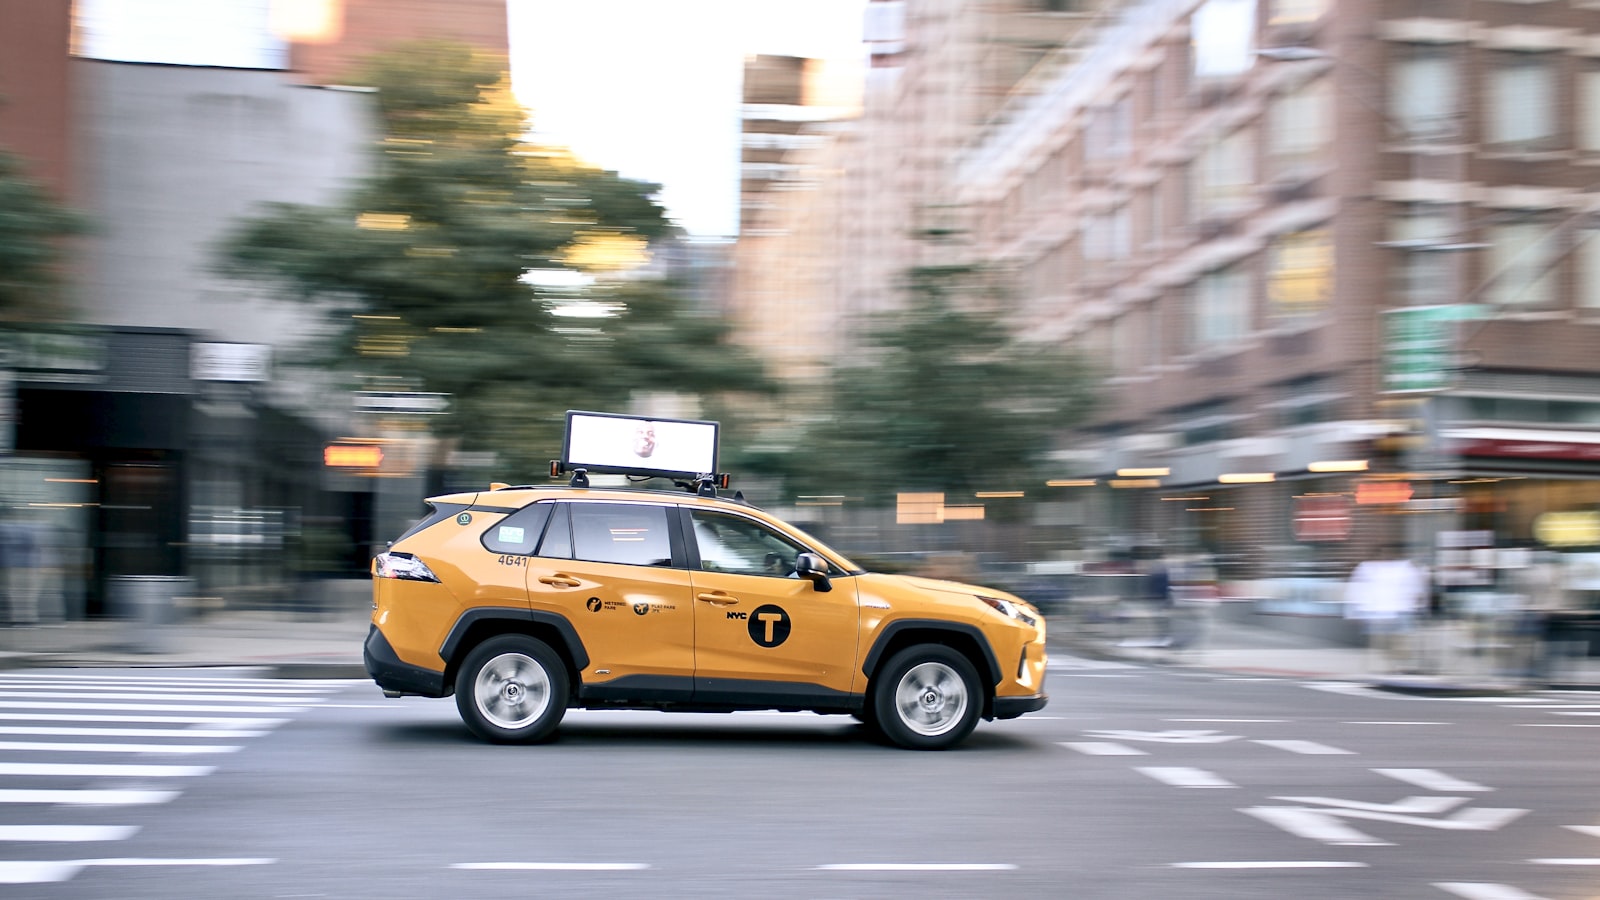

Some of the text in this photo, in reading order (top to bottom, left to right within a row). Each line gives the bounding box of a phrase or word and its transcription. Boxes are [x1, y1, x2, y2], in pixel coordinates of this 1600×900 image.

[498, 555, 527, 567] 4G41
[727, 612, 747, 620] NYC
[757, 612, 782, 643] T
